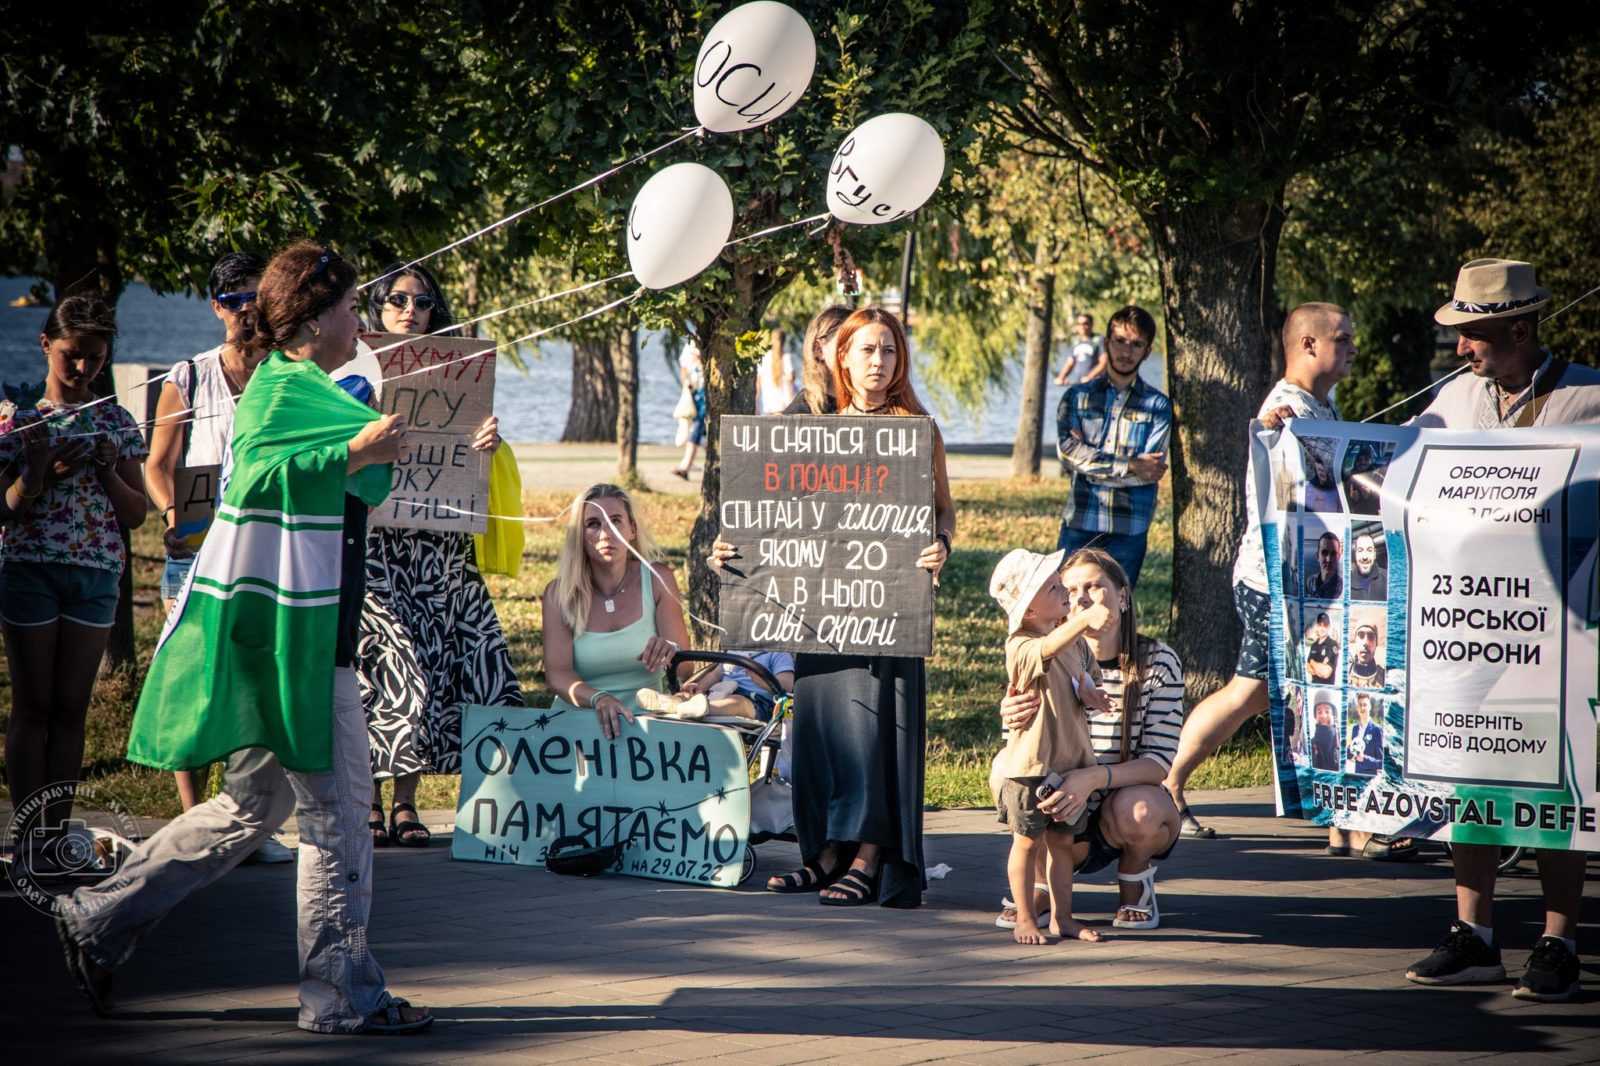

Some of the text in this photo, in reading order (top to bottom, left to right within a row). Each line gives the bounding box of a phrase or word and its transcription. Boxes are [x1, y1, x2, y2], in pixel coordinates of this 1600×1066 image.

[361, 333, 496, 383] АХМУТ
[733, 425, 917, 457] ЧИ СНЯТЬСЯ СНИ
[763, 463, 890, 496] В ПОЛОНІ?
[1449, 465, 1541, 482] ОБОРОНЦІ
[1437, 485, 1539, 501] МАРІУПОЛЯ
[721, 496, 803, 529] СПИТАЙ
[811, 501, 826, 530] У
[759, 537, 888, 571] ЯКОМУ 20
[764, 575, 885, 609] А В НЬОГО
[1432, 574, 1530, 598] 23 ЗАГІН
[1420, 606, 1548, 632] МОРСЬКОЇ
[1423, 639, 1541, 665] ОХОРОНИ
[1434, 712, 1523, 731] ПОВЕРНІТЬ
[1418, 731, 1548, 755] ГЕРОЇВ ДОДОМУ
[1312, 782, 1596, 832] FREE AZOVSTAL DEFE
[651, 857, 724, 882] 29.07.22
